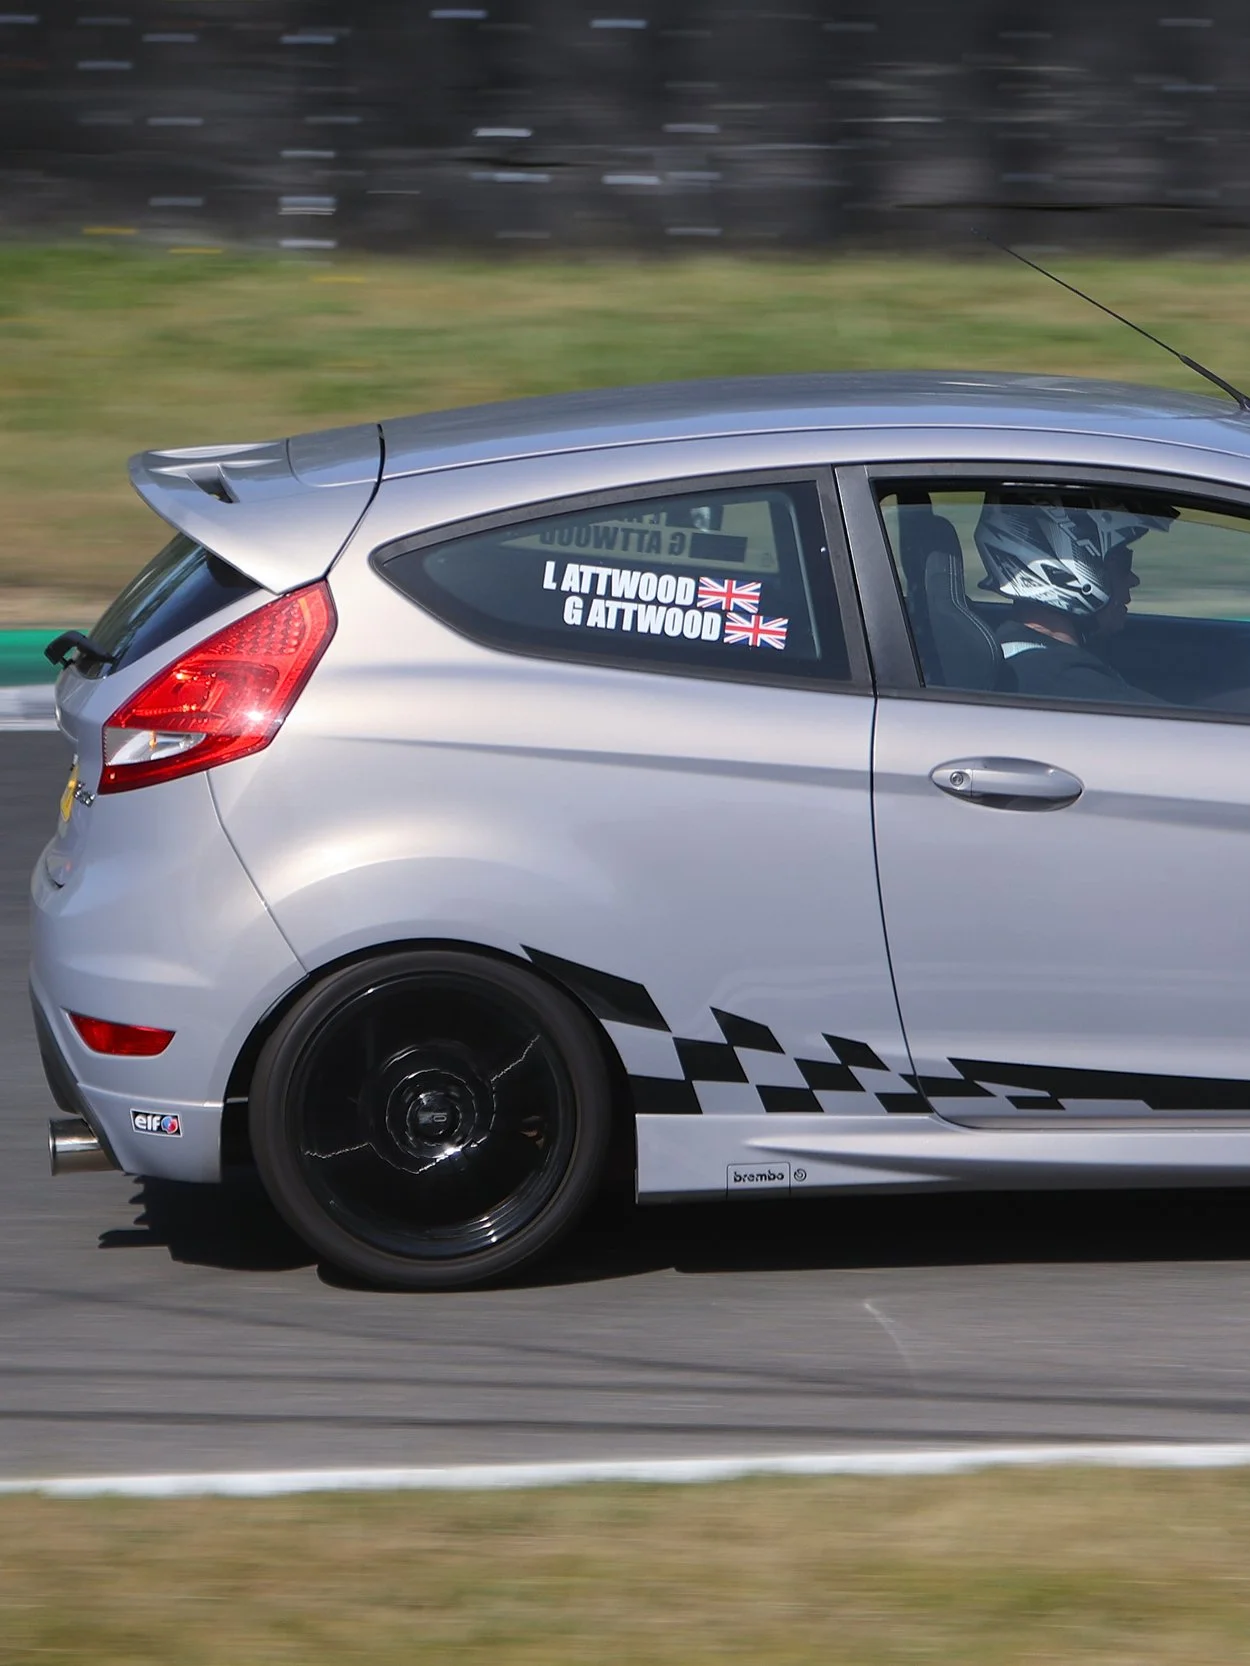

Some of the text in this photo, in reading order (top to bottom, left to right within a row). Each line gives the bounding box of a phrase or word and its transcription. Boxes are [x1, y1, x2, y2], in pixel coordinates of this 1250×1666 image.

[543, 560, 696, 606] L ATTWOOD
[563, 596, 722, 641] G ATTWOOD
[134, 1113, 161, 1131] elf
[733, 1170, 785, 1183] brembo
